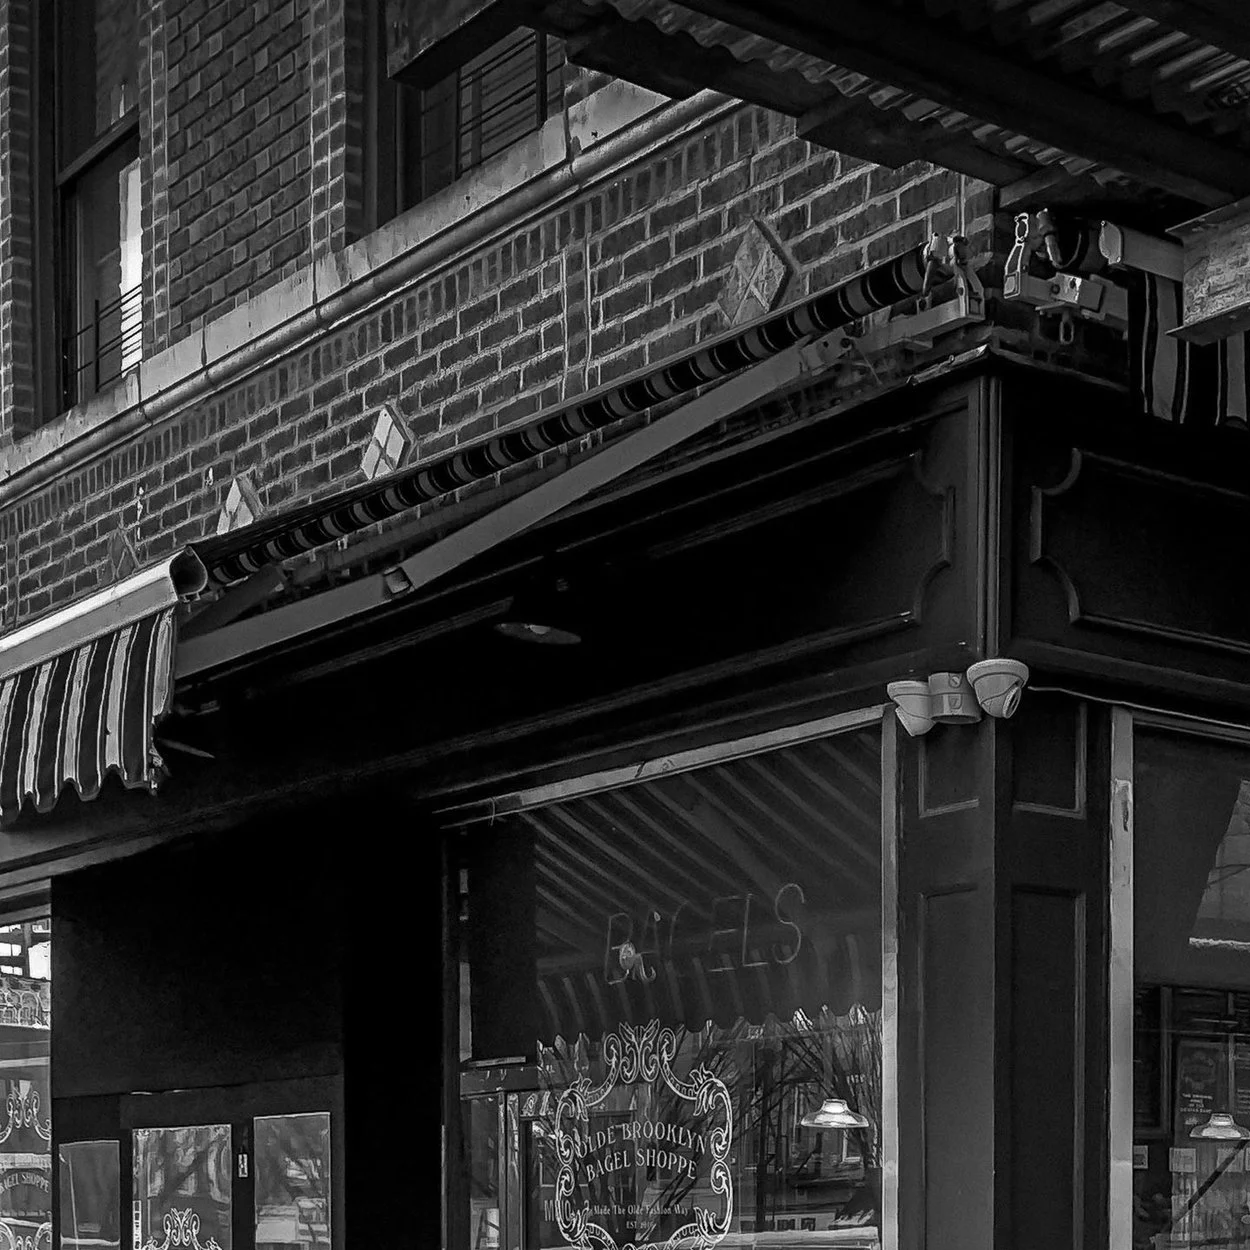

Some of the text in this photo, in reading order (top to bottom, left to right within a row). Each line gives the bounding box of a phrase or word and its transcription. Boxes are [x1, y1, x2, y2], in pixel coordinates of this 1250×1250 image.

[575, 1120, 708, 1158] OLDE BROOKLYN
[586, 1148, 697, 1182] BAGEL SHOPPE
[674, 1204, 689, 1216] Way
